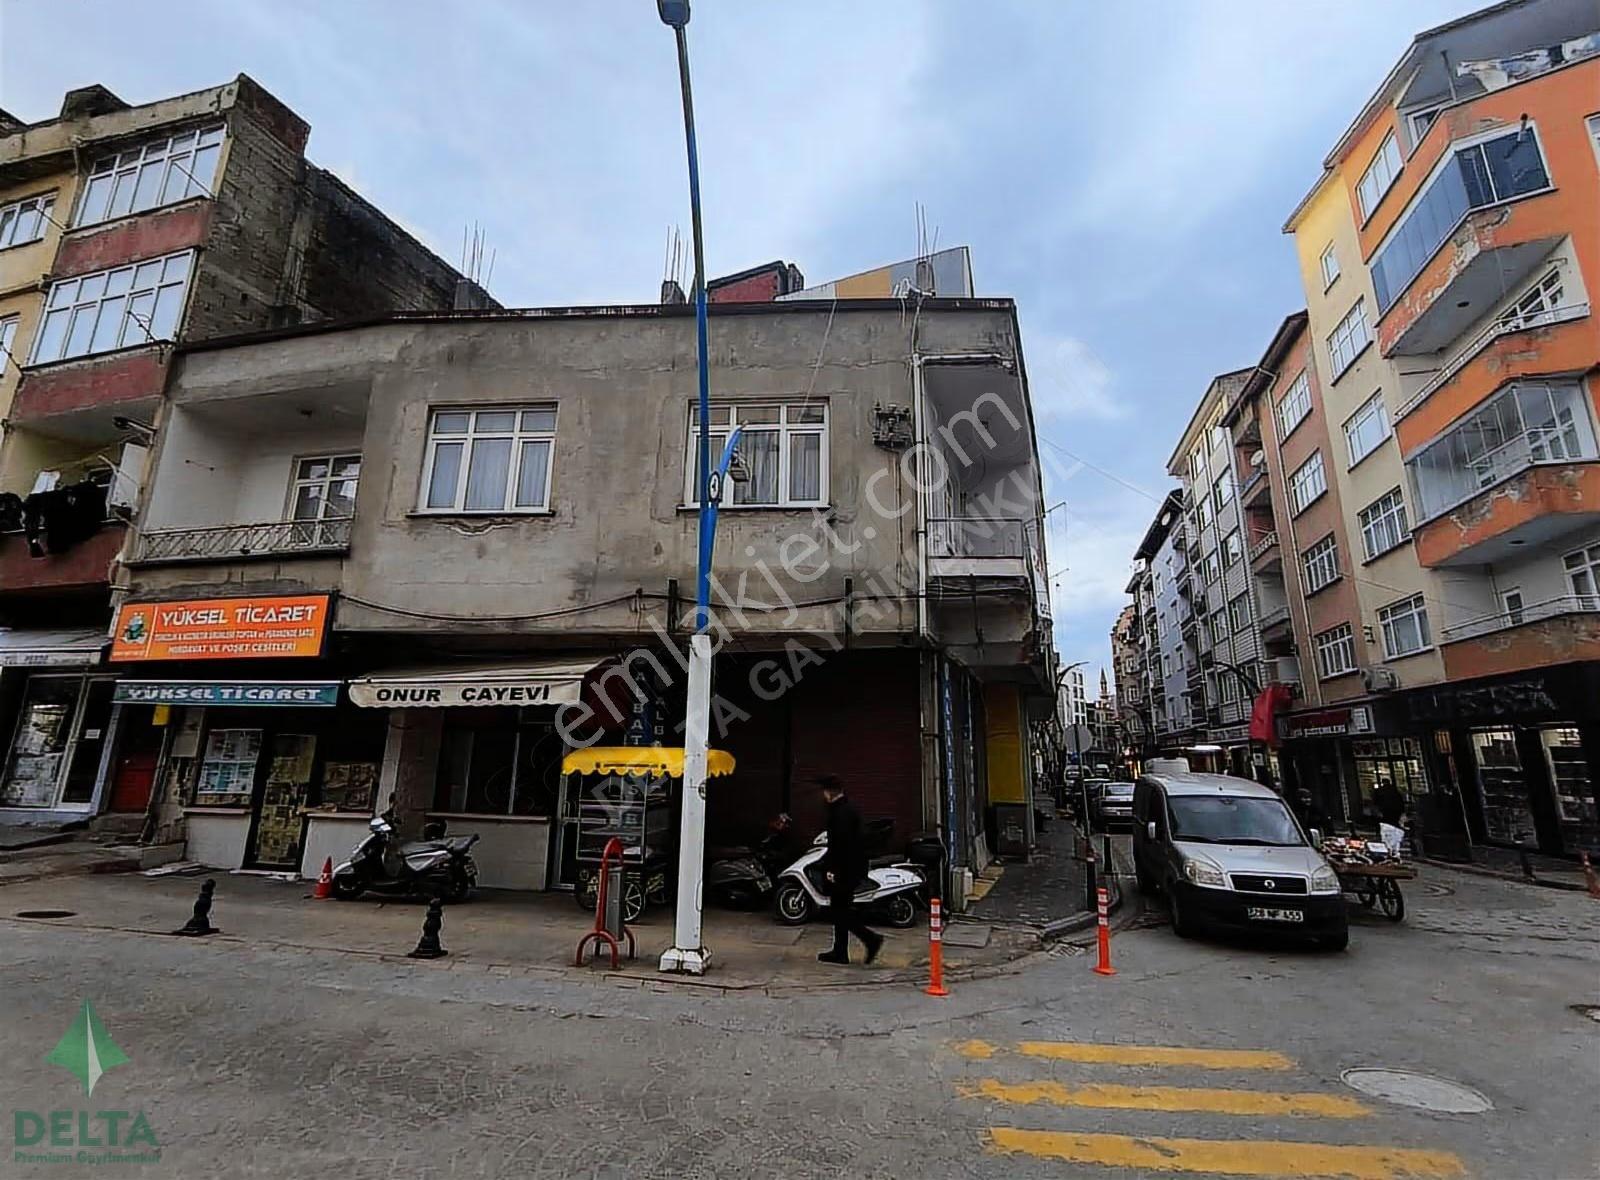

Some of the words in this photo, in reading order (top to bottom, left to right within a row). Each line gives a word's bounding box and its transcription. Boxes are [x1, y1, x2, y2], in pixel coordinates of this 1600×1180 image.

[162, 607, 229, 626] YÜKSEL
[234, 603, 317, 622] TİCARET
[128, 685, 214, 701] YÜKSEL
[219, 685, 321, 700] TİCARET
[376, 688, 441, 702] ONUR
